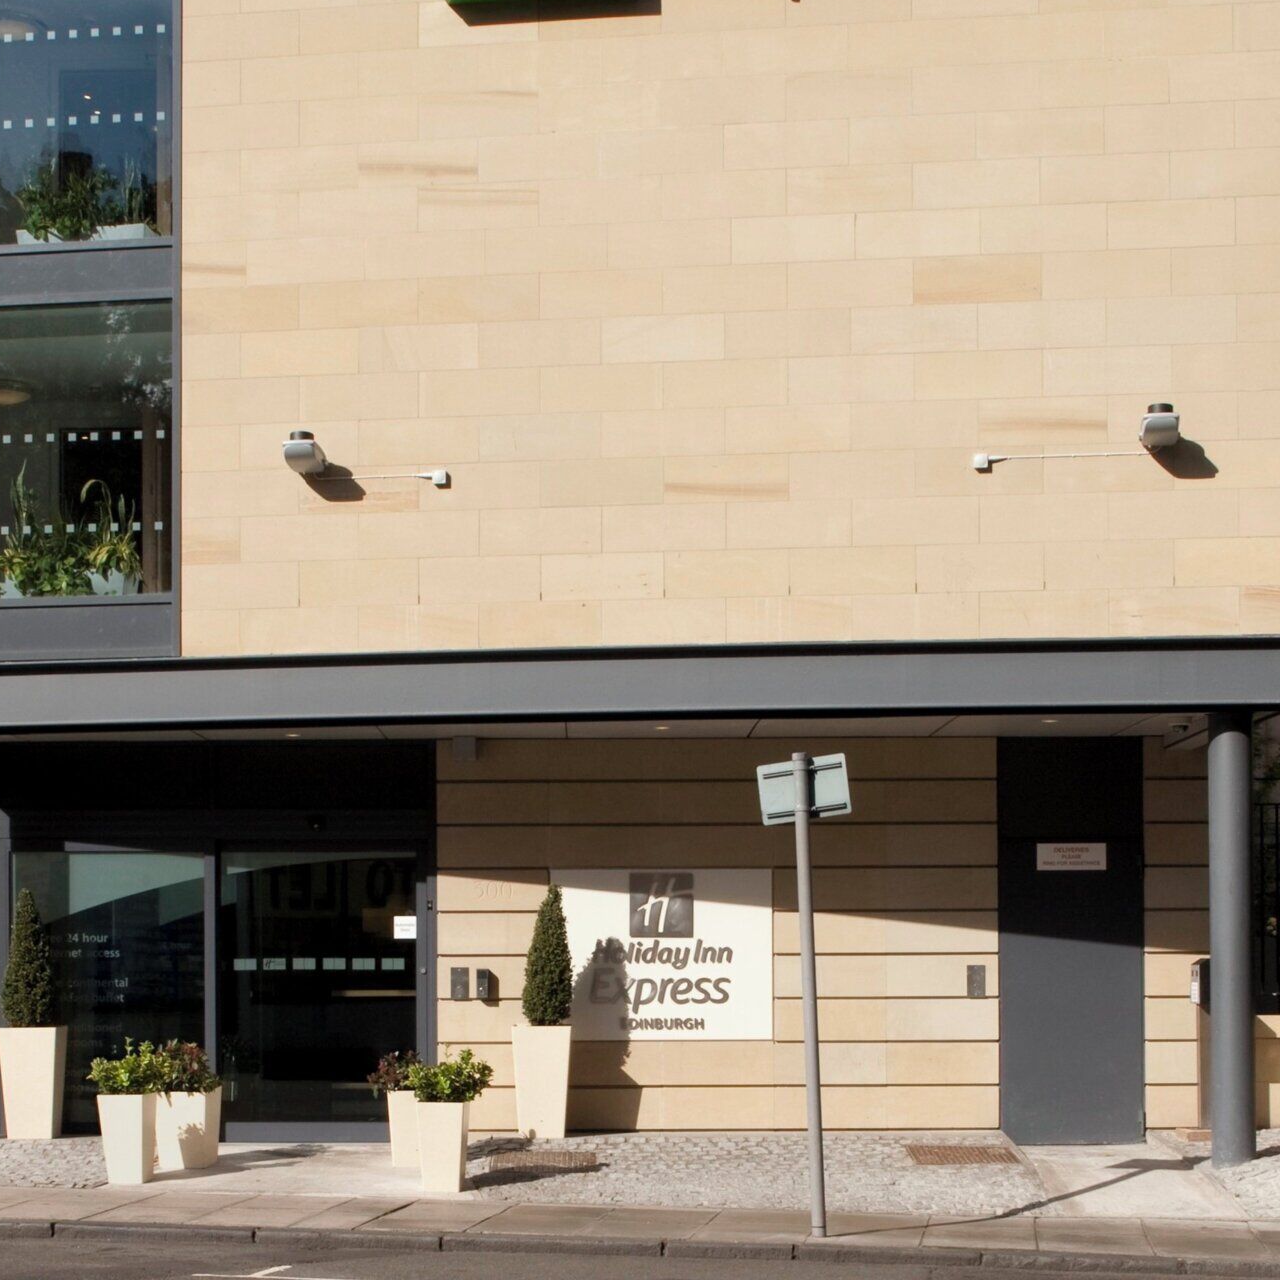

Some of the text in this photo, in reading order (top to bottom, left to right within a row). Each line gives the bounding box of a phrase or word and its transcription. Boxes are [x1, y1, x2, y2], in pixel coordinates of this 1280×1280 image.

[81, 932, 109, 943] hour
[593, 938, 733, 970] Holiday Inn
[590, 967, 731, 1015] Express
[620, 1017, 705, 1030] EDINBURGH
